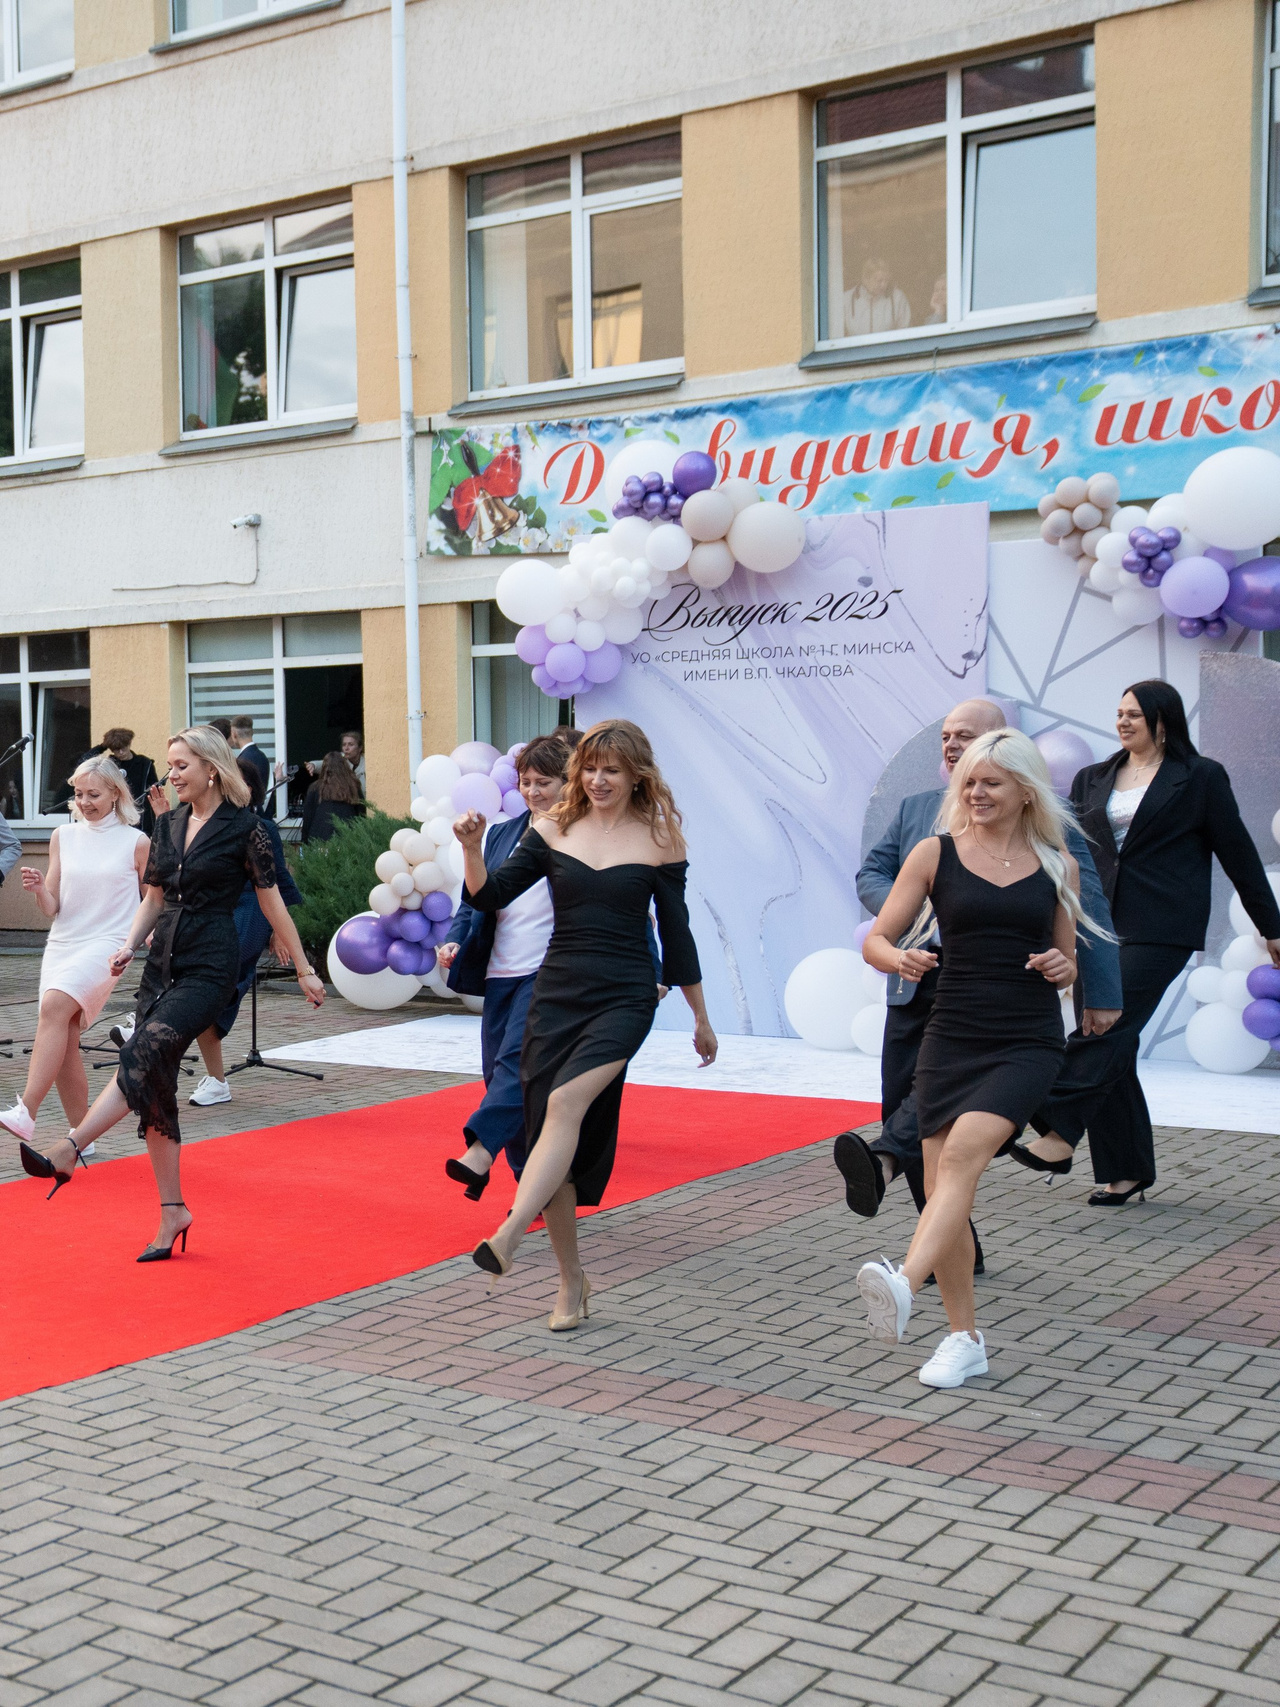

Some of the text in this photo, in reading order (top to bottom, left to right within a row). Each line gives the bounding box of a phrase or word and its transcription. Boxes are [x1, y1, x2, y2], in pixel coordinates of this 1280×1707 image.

[706, 413, 1061, 511] видания,
[642, 583, 904, 646] Выпуск 2025
[654, 648, 731, 664] «СРЕДНЯЯ
[736, 645, 795, 660] ШКОЛА
[843, 640, 916, 656] МИНСКА
[683, 664, 855, 682] ИМЕНИ В.П. ЧКАЛОВА
